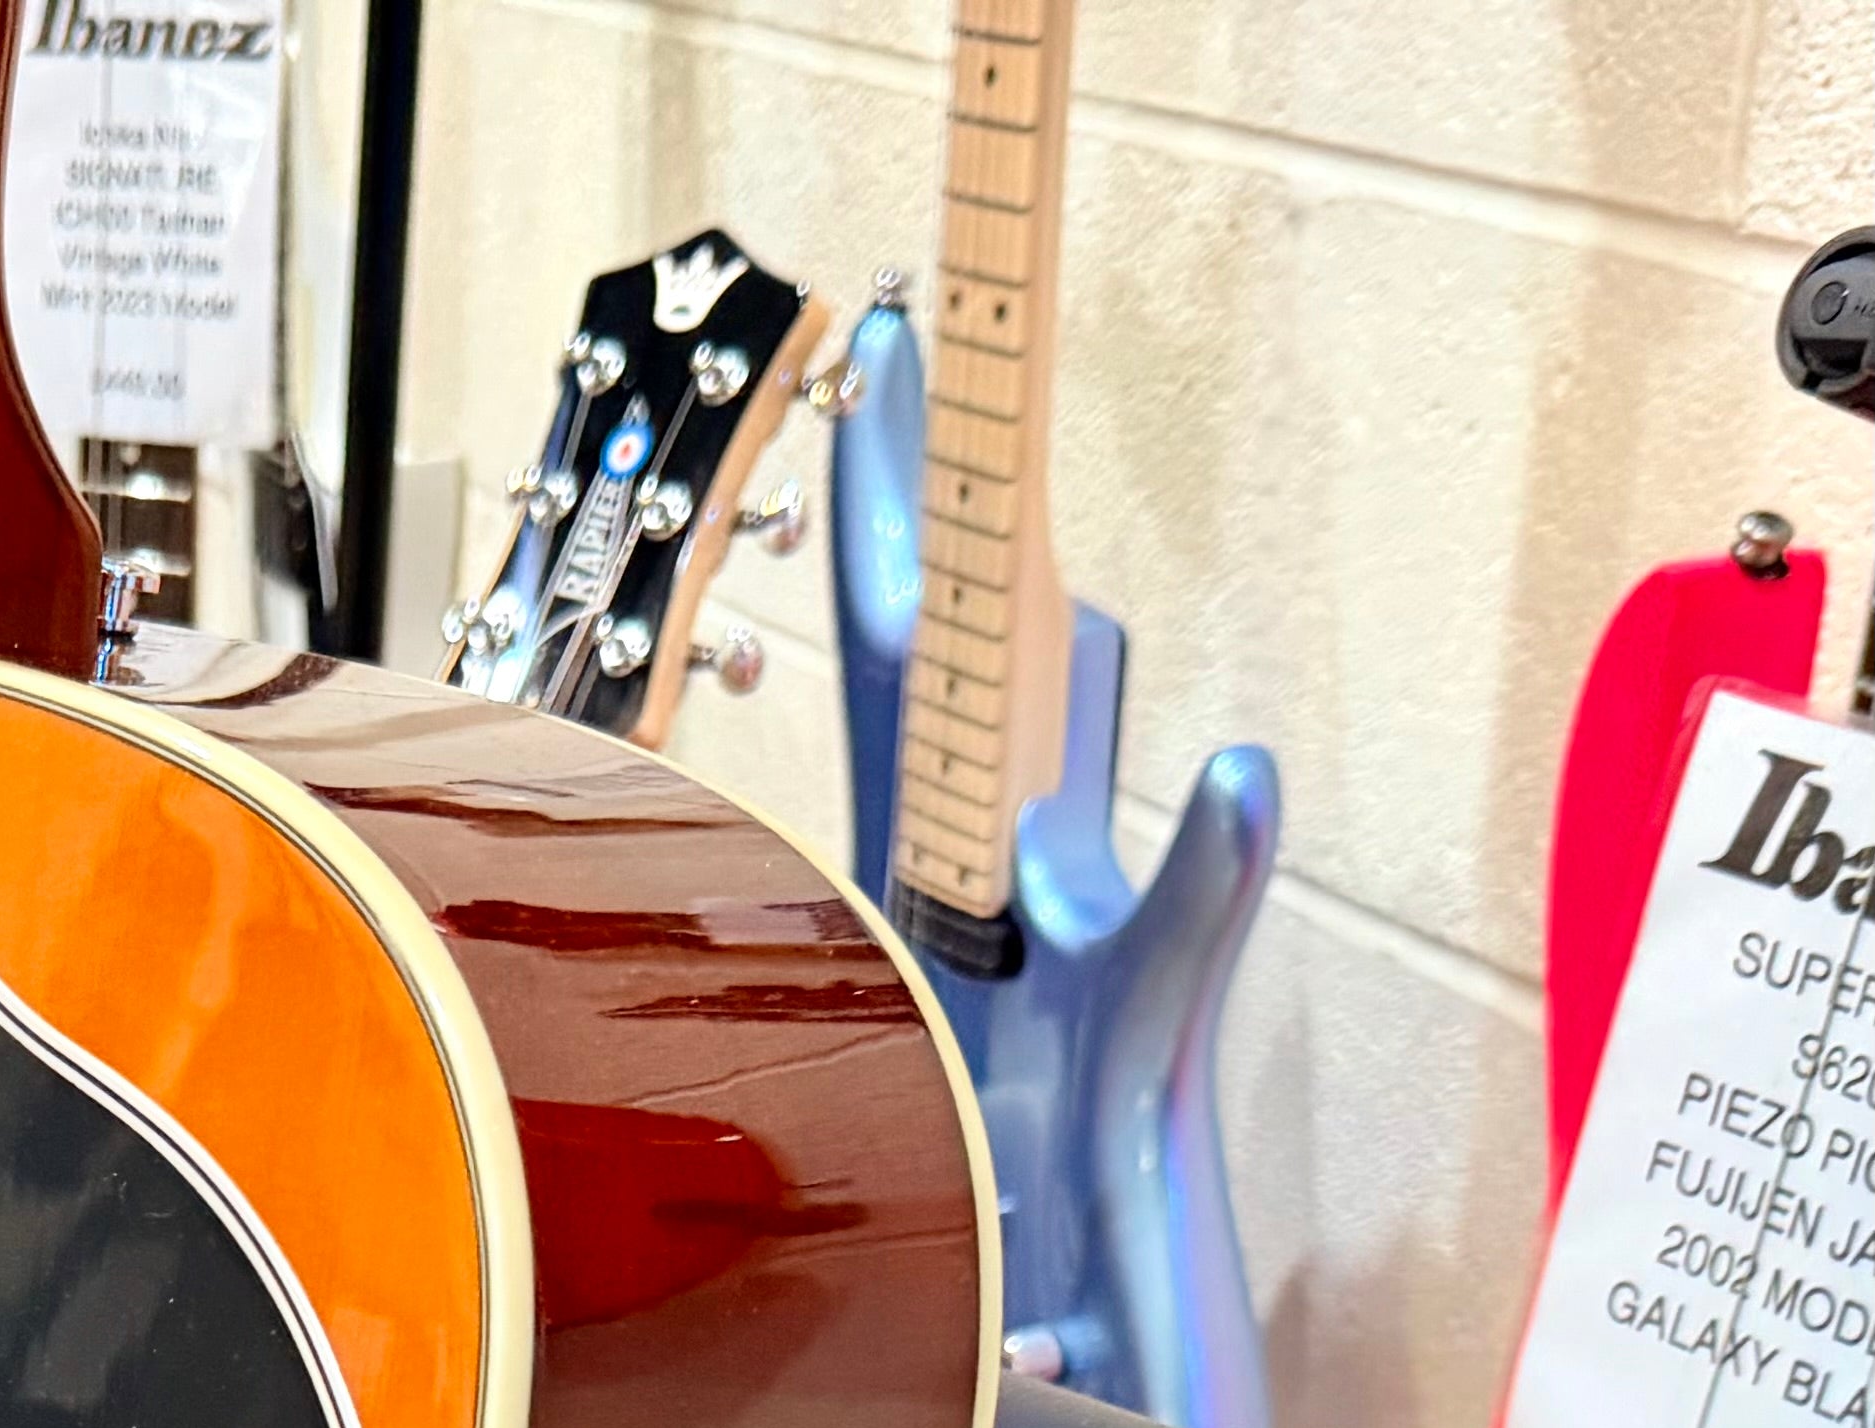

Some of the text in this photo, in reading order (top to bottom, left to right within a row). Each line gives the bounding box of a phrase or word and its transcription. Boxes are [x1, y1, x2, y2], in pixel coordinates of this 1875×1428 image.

[28, 0, 273, 61] Ibanez
[1678, 1072, 1814, 1158] PIEZO
[1645, 1140, 1824, 1248] FUJIJEN
[1657, 1224, 1758, 1299] 2002
[1607, 1281, 1779, 1386] GALAXY
